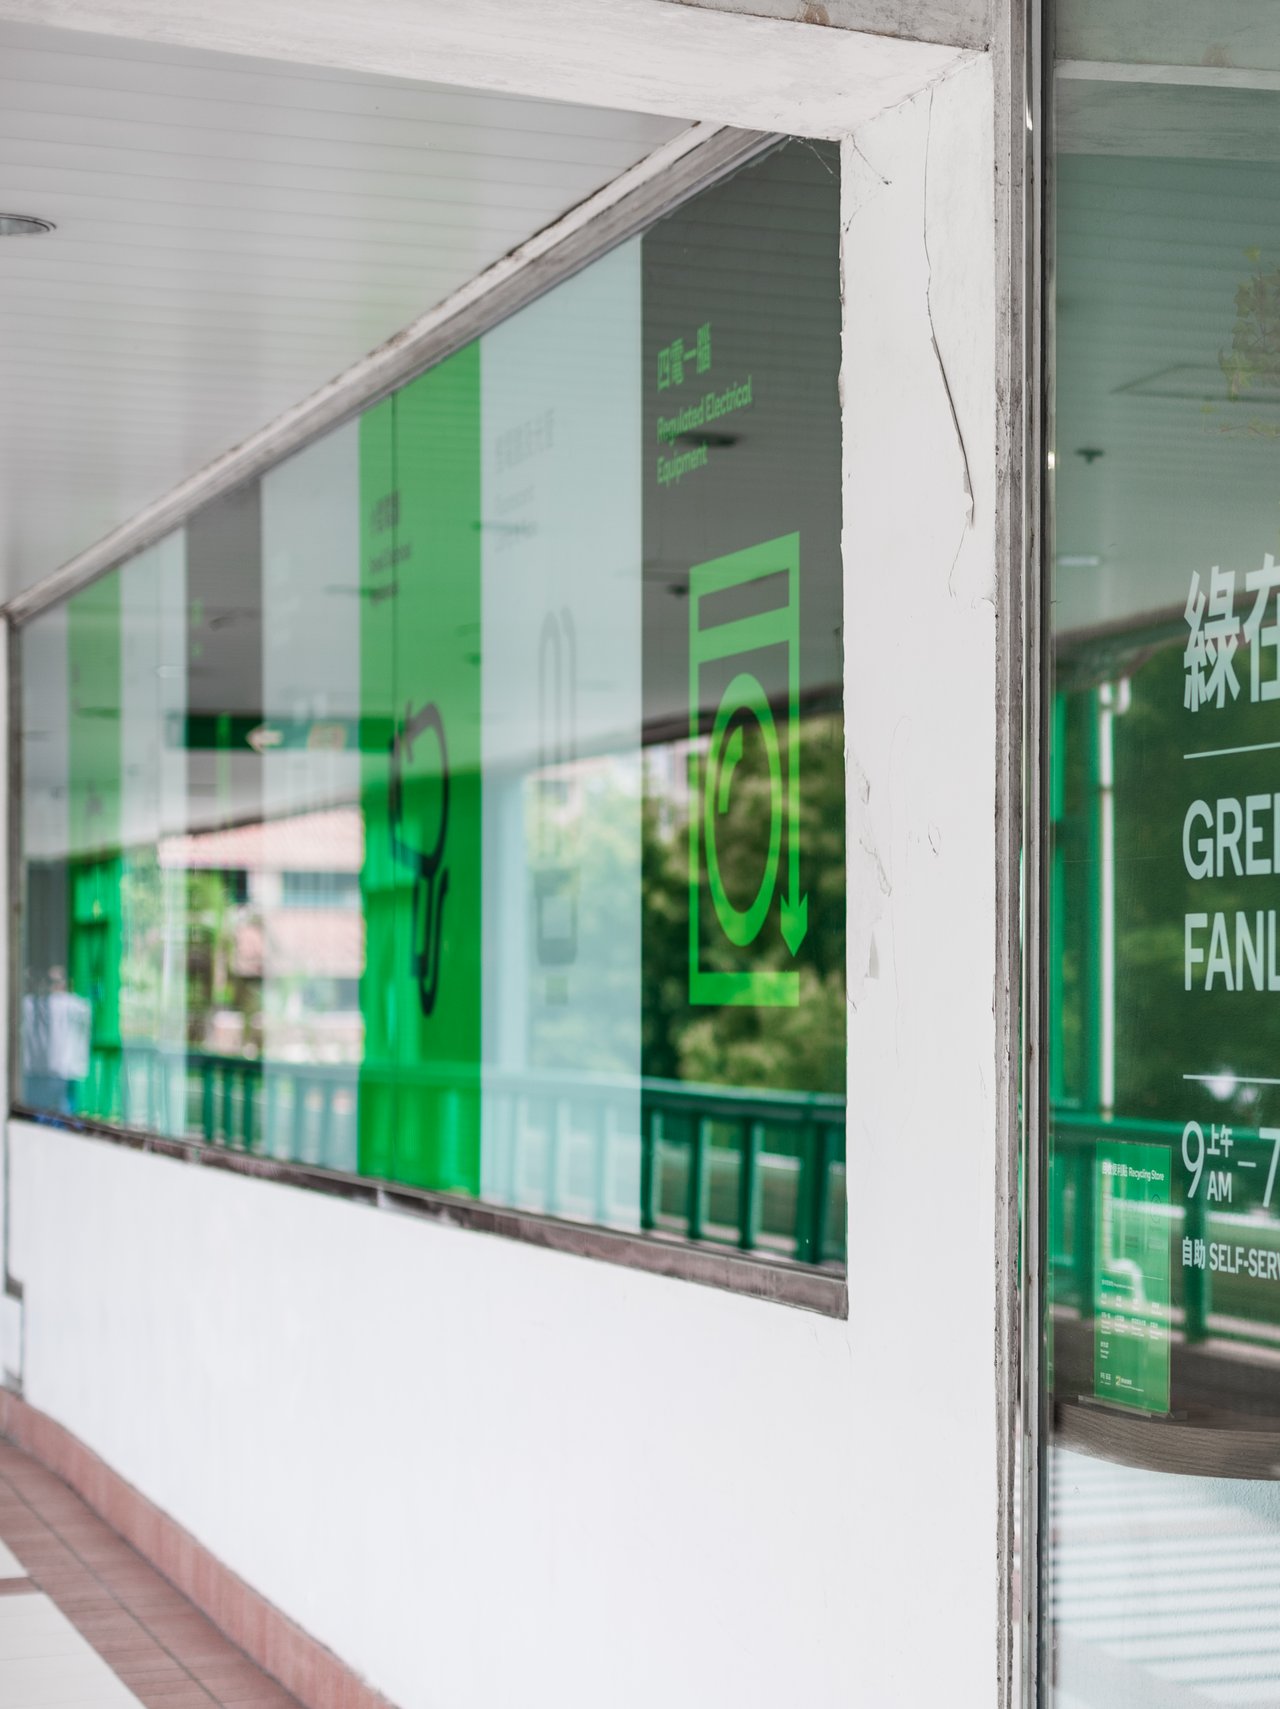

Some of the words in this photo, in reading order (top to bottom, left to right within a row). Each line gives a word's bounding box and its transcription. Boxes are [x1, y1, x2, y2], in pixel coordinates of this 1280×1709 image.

[705, 374, 752, 422] Electrical
[657, 440, 708, 487] Equipment
[1129, 1166, 1151, 1182] Recycling
[1151, 1169, 1165, 1181] Store
[1182, 1120, 1205, 1199] 9
[1207, 1123, 1234, 1158] 上午
[1207, 1170, 1233, 1203] AM
[1182, 1236, 1206, 1270] 自助
